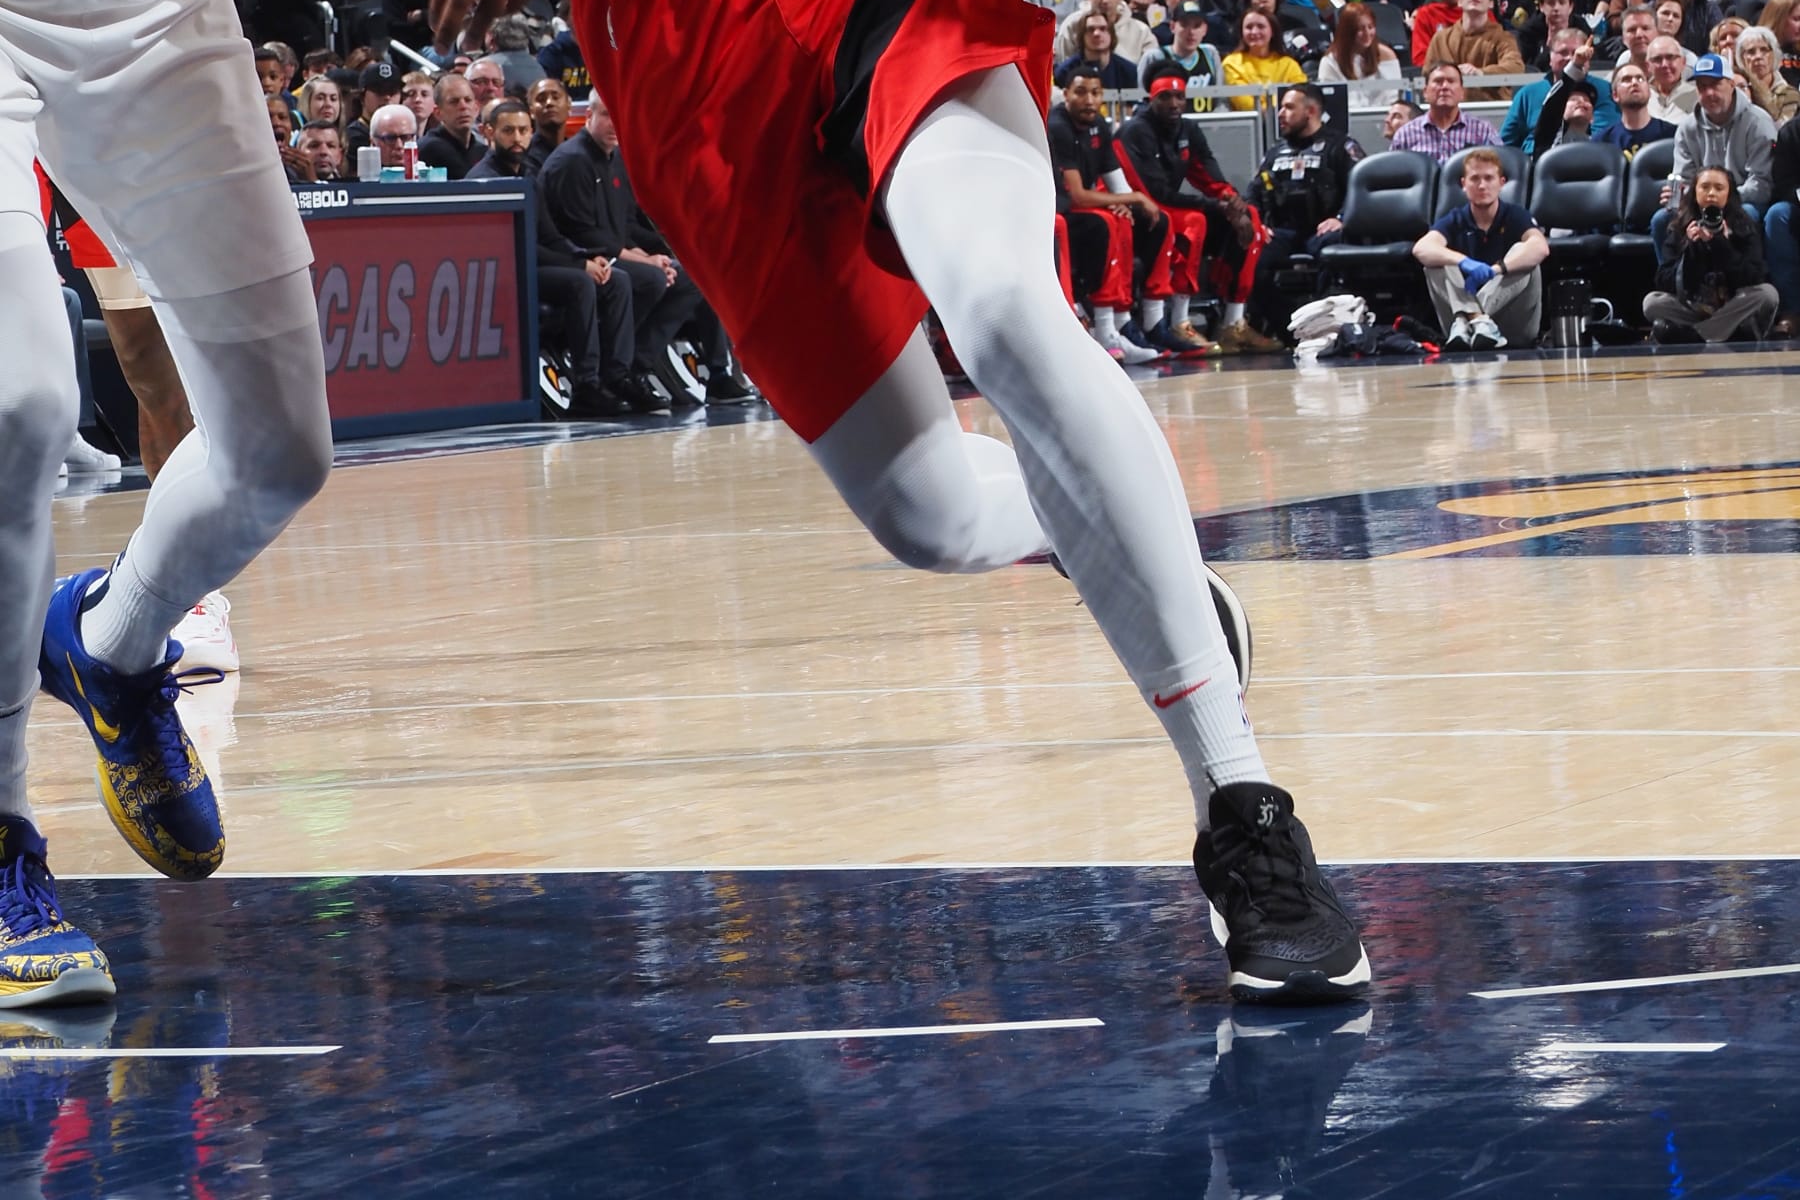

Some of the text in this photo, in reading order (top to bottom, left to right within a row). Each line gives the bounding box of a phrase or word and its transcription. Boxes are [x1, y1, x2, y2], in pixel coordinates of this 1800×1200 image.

[313, 189, 348, 209] BOLD
[311, 257, 504, 375] CAS OIL
